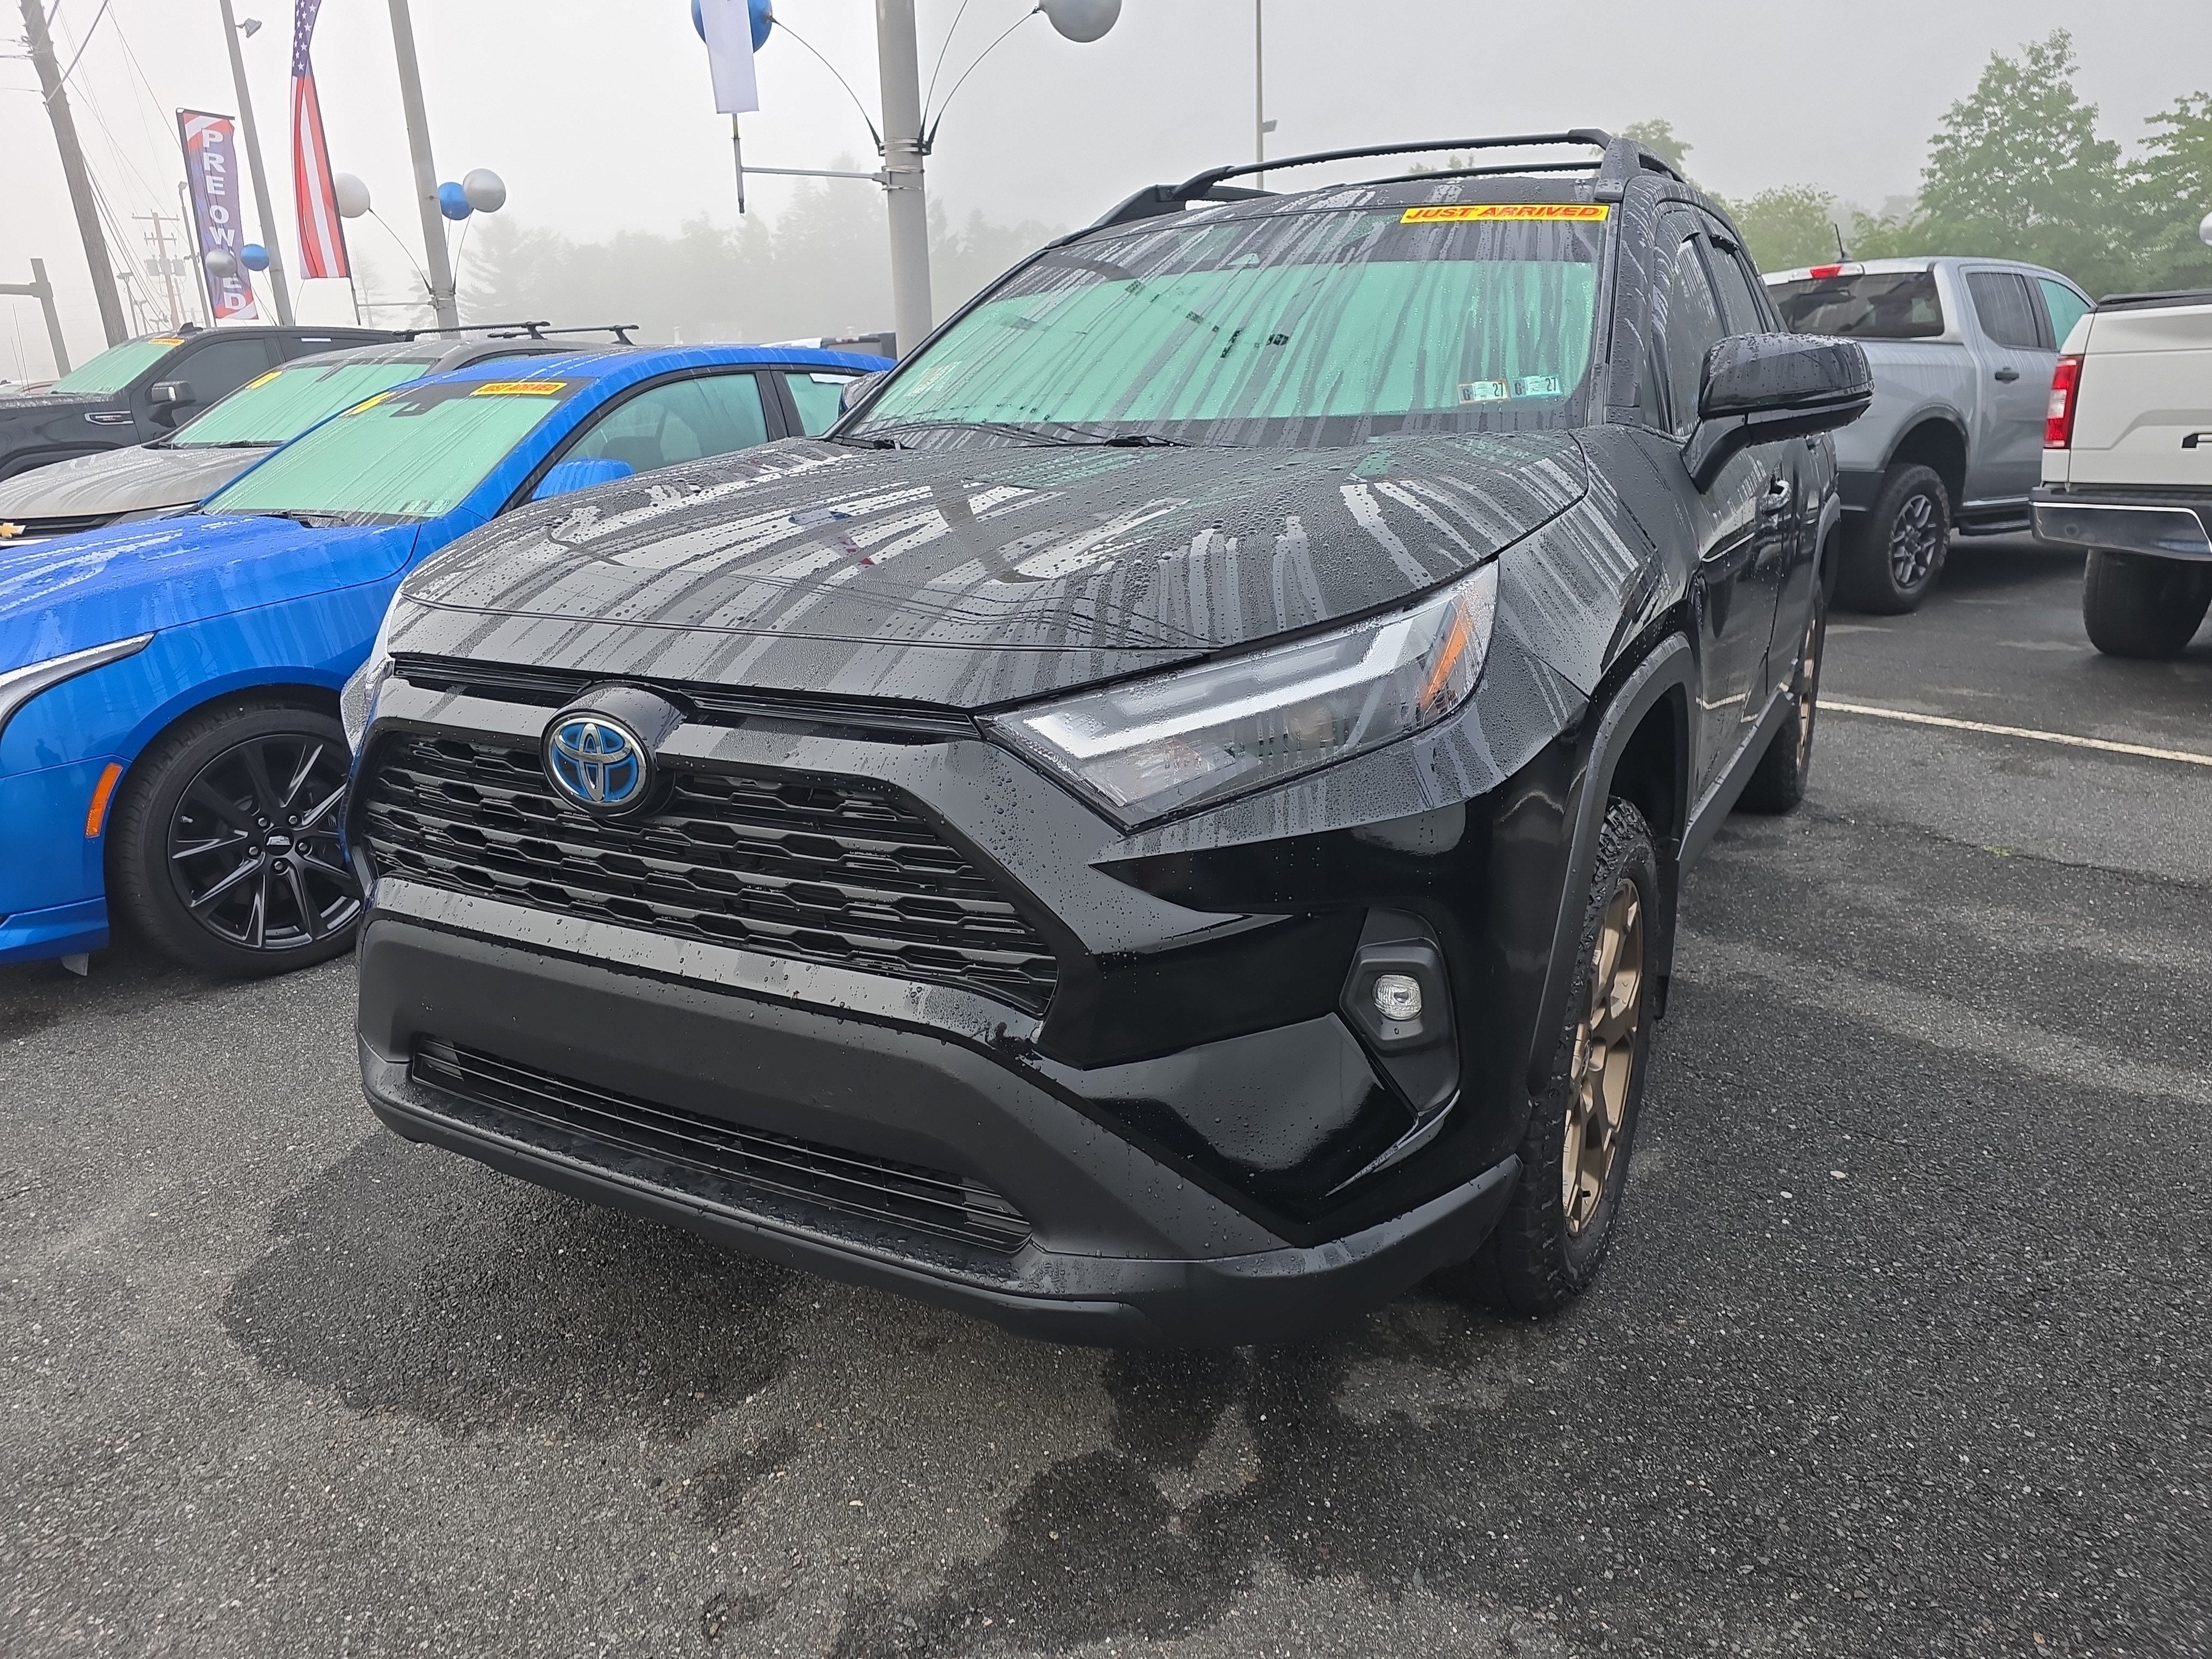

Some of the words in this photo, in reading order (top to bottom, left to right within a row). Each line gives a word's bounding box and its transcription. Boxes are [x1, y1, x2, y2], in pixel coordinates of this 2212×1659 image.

[201, 128, 227, 196] PRE
[1406, 208, 1477, 220] JUST
[1477, 207, 1602, 217] ARRIVED
[209, 205, 246, 310] OWED
[1492, 382, 1504, 397] 27
[1545, 377, 1557, 392] 27
